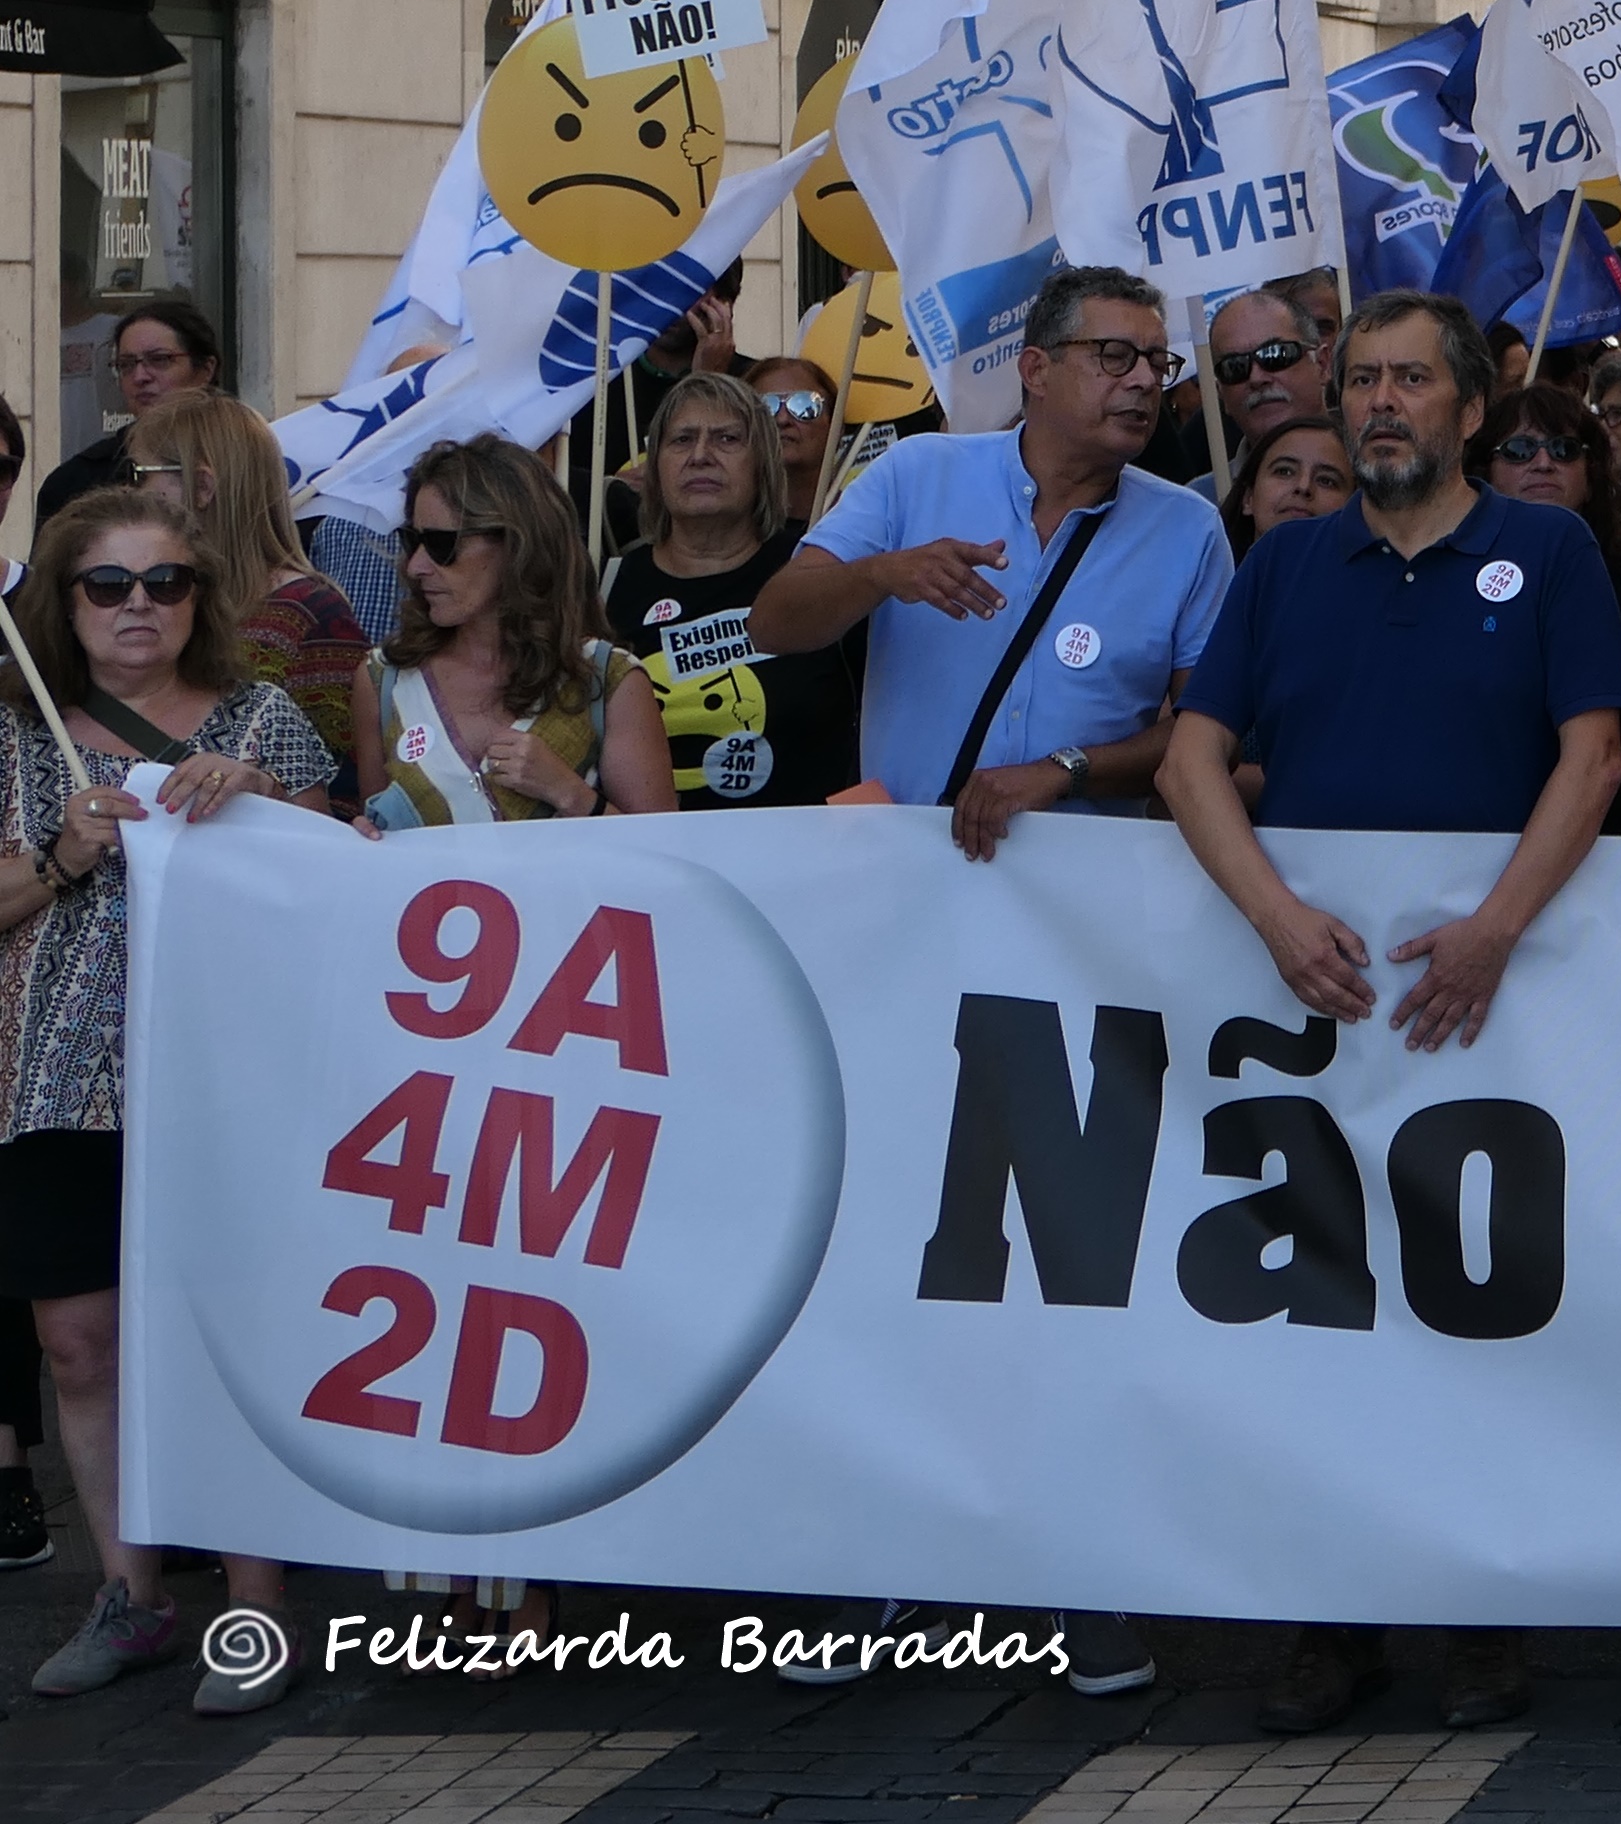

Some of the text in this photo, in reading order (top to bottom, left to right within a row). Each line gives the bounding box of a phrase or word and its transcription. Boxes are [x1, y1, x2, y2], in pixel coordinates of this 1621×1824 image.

[629, 1, 717, 55] NÃO!
[24, 19, 46, 56] Bar
[102, 138, 152, 199] MEAT
[103, 210, 152, 259] friends
[1495, 564, 1515, 580] 9A
[1481, 583, 1501, 598] 2D
[1487, 574, 1511, 590] 4M
[654, 601, 672, 613] 9A
[669, 617, 748, 653] Exigim
[1071, 627, 1090, 642] 9A
[1065, 639, 1089, 654] 4M
[675, 637, 753, 674] Respei
[1062, 650, 1083, 665] 2D
[407, 726, 425, 740] 9A
[406, 735, 426, 749] 4M
[726, 737, 756, 754] 9A
[407, 747, 425, 761] 2D
[720, 754, 756, 772] 4M
[719, 774, 751, 791] 2D
[383, 878, 670, 1078] 9A
[320, 1069, 662, 1271] 4M
[915, 992, 1567, 1341] Não
[299, 1264, 591, 1456] 2D
